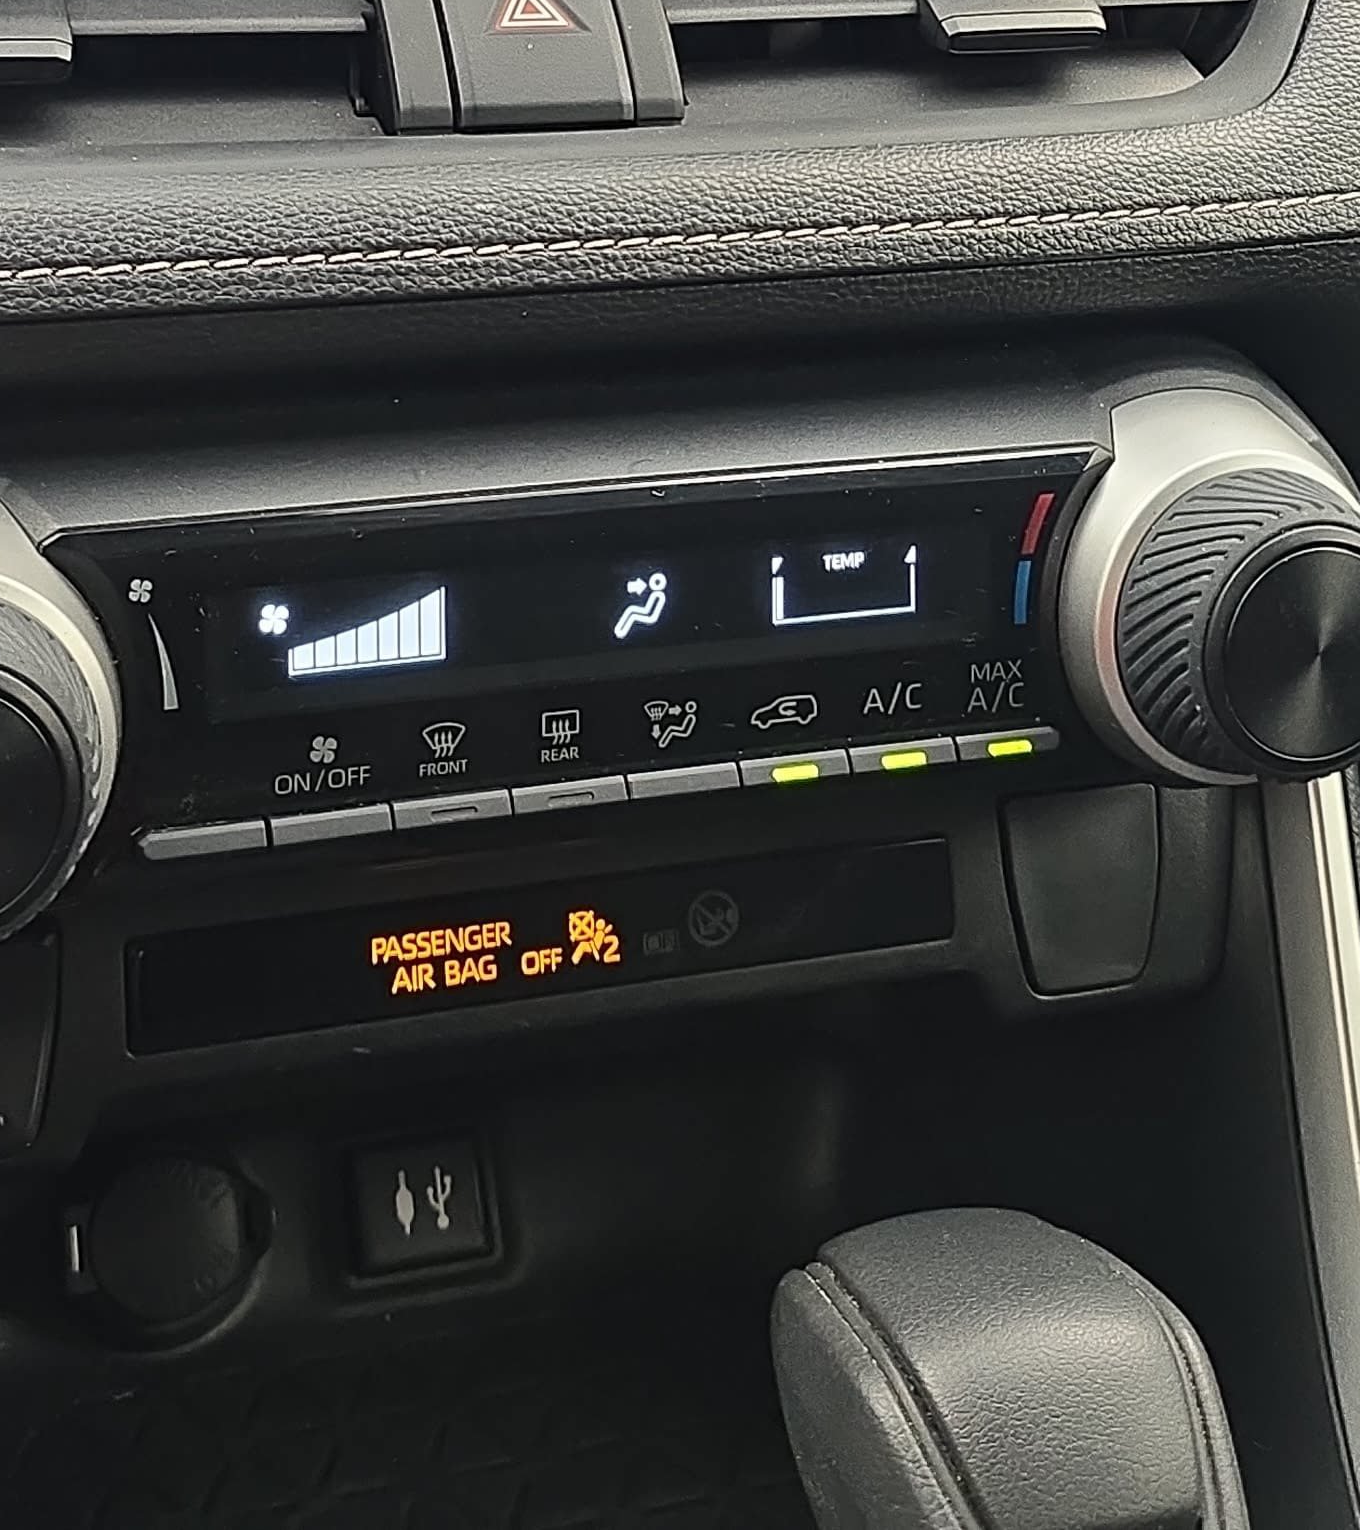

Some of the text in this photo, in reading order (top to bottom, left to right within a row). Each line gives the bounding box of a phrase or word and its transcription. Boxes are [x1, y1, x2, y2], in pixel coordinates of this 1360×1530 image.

[822, 551, 865, 571] TEMP
[970, 659, 1024, 683] MAX
[863, 681, 922, 715] A/C
[967, 681, 1025, 713] A/C
[419, 758, 468, 777] FRONT
[540, 746, 580, 763] REAR
[274, 765, 371, 795] ON/OFF
[371, 921, 513, 965] PASSENGER
[391, 962, 437, 995] AIR
[444, 954, 498, 987] BAG
[520, 947, 563, 976] OFF
